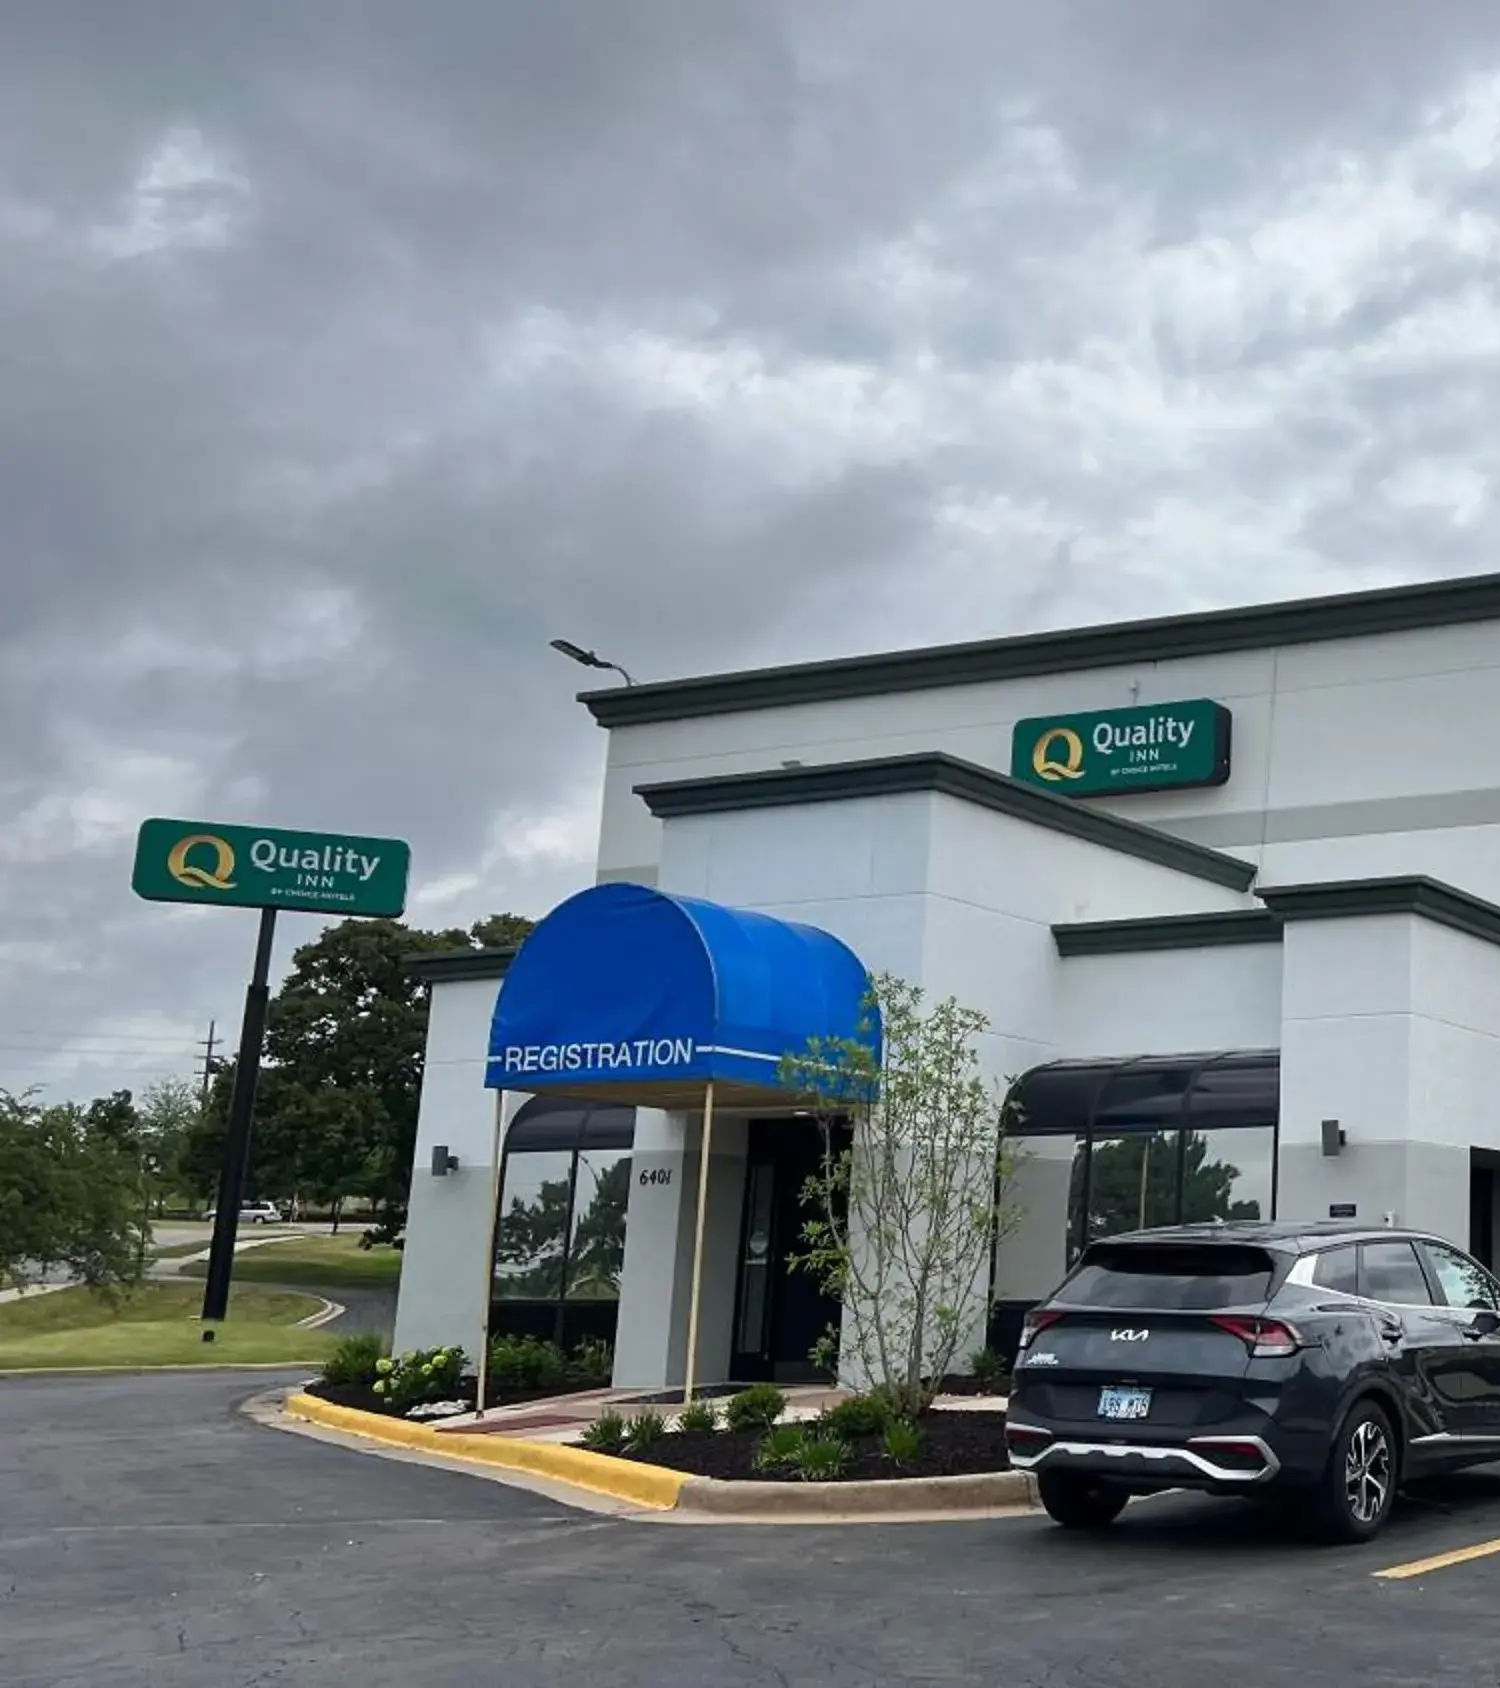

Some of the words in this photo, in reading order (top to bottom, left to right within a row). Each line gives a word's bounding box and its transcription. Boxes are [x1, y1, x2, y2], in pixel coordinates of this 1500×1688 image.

[1093, 716, 1195, 754] Quality
[1033, 728, 1086, 781] Q
[1130, 748, 1160, 763] INN
[167, 833, 237, 889] Q
[250, 839, 381, 881] Quality
[297, 873, 336, 888] INN
[505, 1037, 694, 1072] REGISTRATION
[639, 1168, 672, 1186] 6401
[1110, 1329, 1150, 1341] KIA
